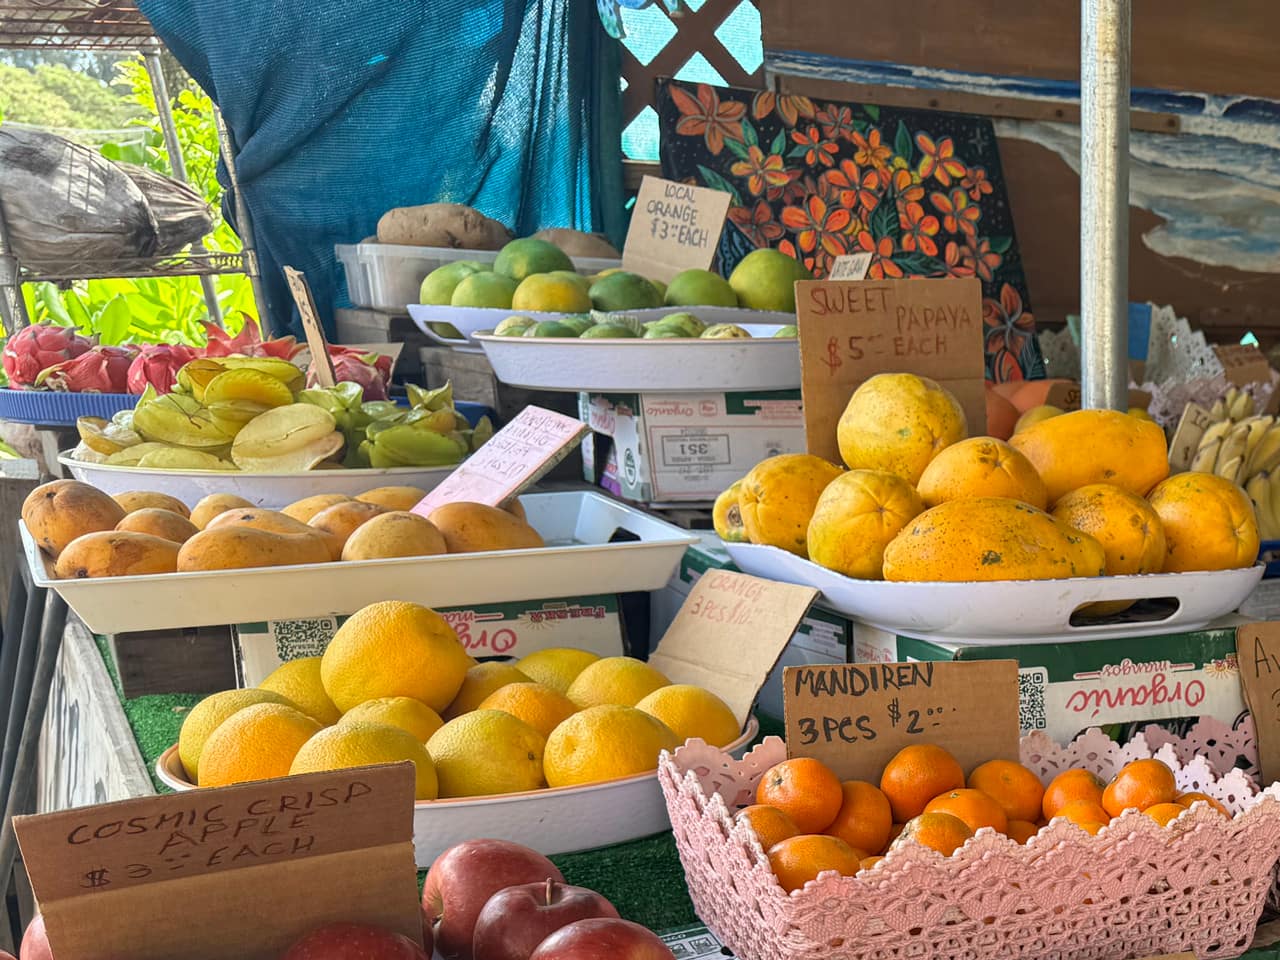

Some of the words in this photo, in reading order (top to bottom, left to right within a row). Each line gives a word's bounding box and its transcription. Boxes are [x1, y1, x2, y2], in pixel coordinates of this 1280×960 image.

[665, 184, 696, 203] LOCAL
[646, 200, 699, 226] ORANGE
[678, 225, 709, 248] EACH
[810, 286, 893, 316] SWEET
[896, 304, 972, 331] PAPAYA
[892, 334, 948, 356] EACH
[795, 661, 934, 698] MANDIREN
[1064, 672, 1206, 718] Organic
[66, 804, 227, 846] COSMIC
[246, 780, 374, 818] CRISP
[158, 810, 316, 856] APPLE
[205, 835, 316, 868] EACH
